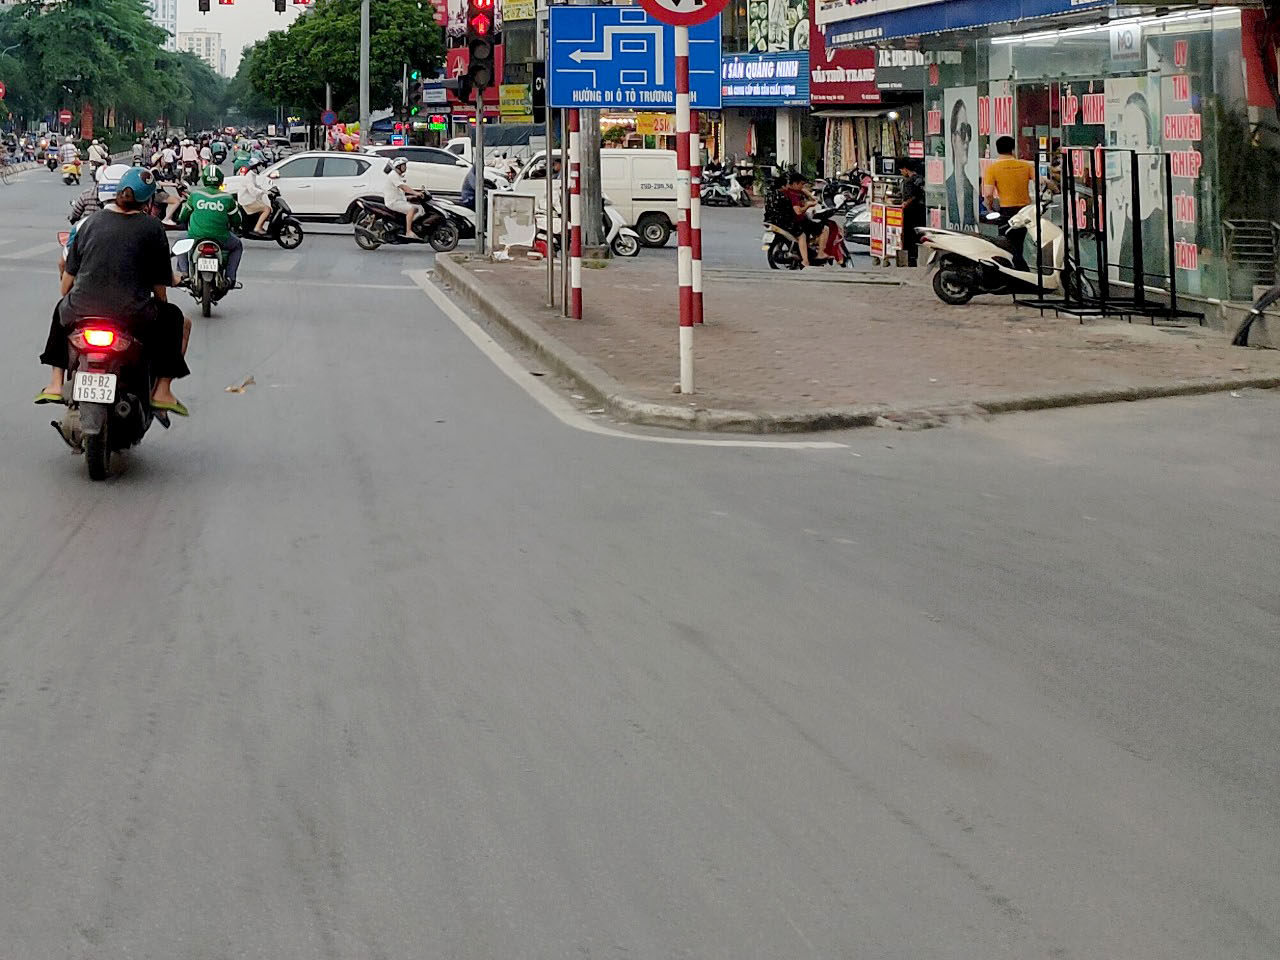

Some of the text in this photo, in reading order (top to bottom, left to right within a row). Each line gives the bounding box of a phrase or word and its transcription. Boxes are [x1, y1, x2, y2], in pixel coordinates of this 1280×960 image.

[745, 55, 775, 80] QUẢNG
[775, 60, 799, 78] NINH
[572, 86, 602, 103] HƯỚNG
[604, 90, 614, 103] ĐI
[615, 87, 623, 103] Ô
[624, 87, 636, 103] TÔ
[638, 90, 673, 103] TRƯƠNG
[1165, 145, 1202, 181] GHIỆP
[196, 199, 225, 212] Grab
[81, 374, 111, 388] 89-B2
[77, 387, 113, 401] 165.32
